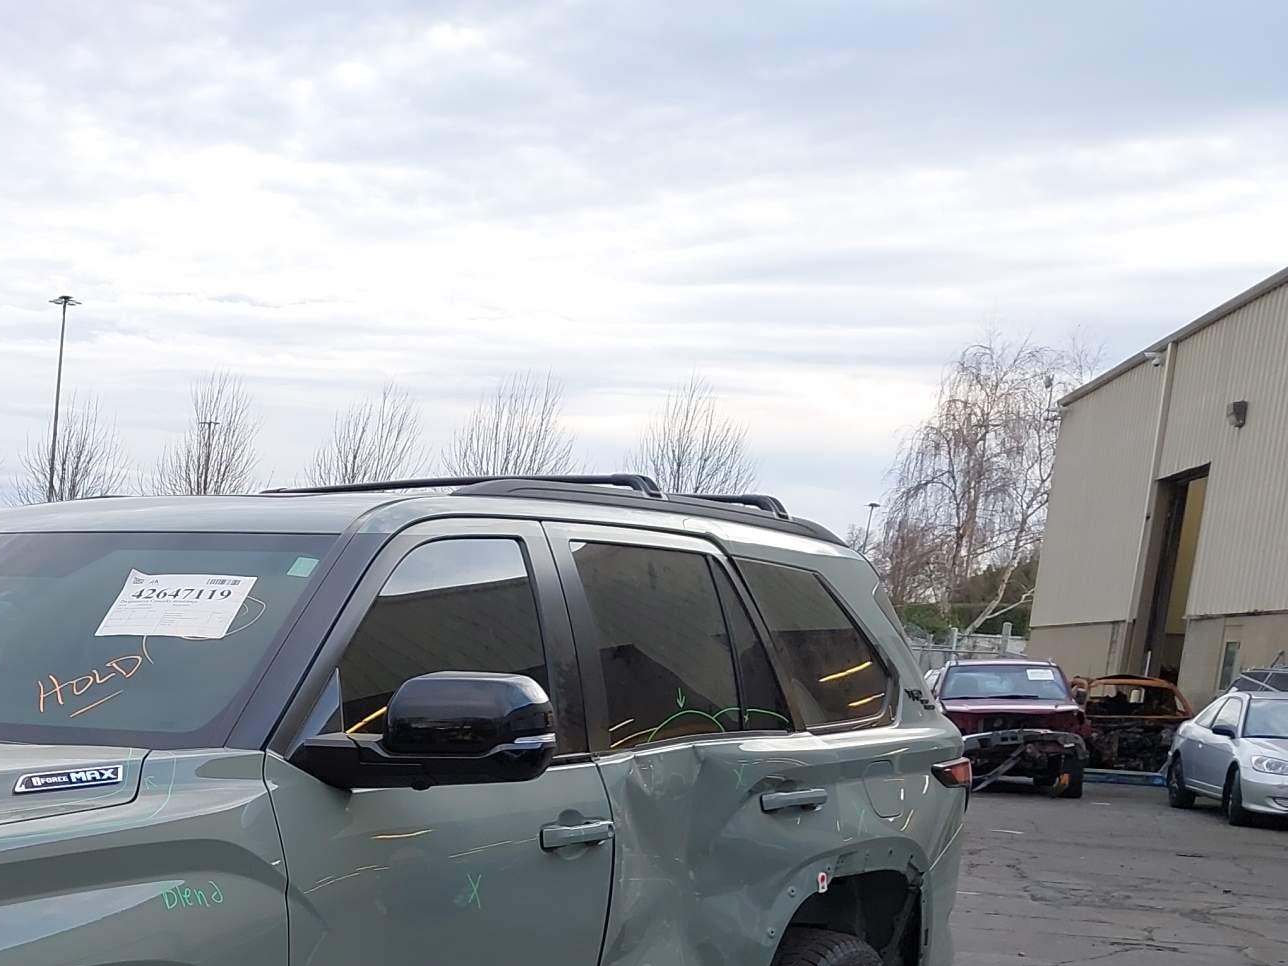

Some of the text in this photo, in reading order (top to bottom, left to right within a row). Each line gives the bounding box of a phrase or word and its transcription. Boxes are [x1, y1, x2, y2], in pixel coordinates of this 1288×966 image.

[131, 588, 232, 601] 42647119
[38, 655, 143, 713] HOLD
[69, 768, 118, 783] MAX
